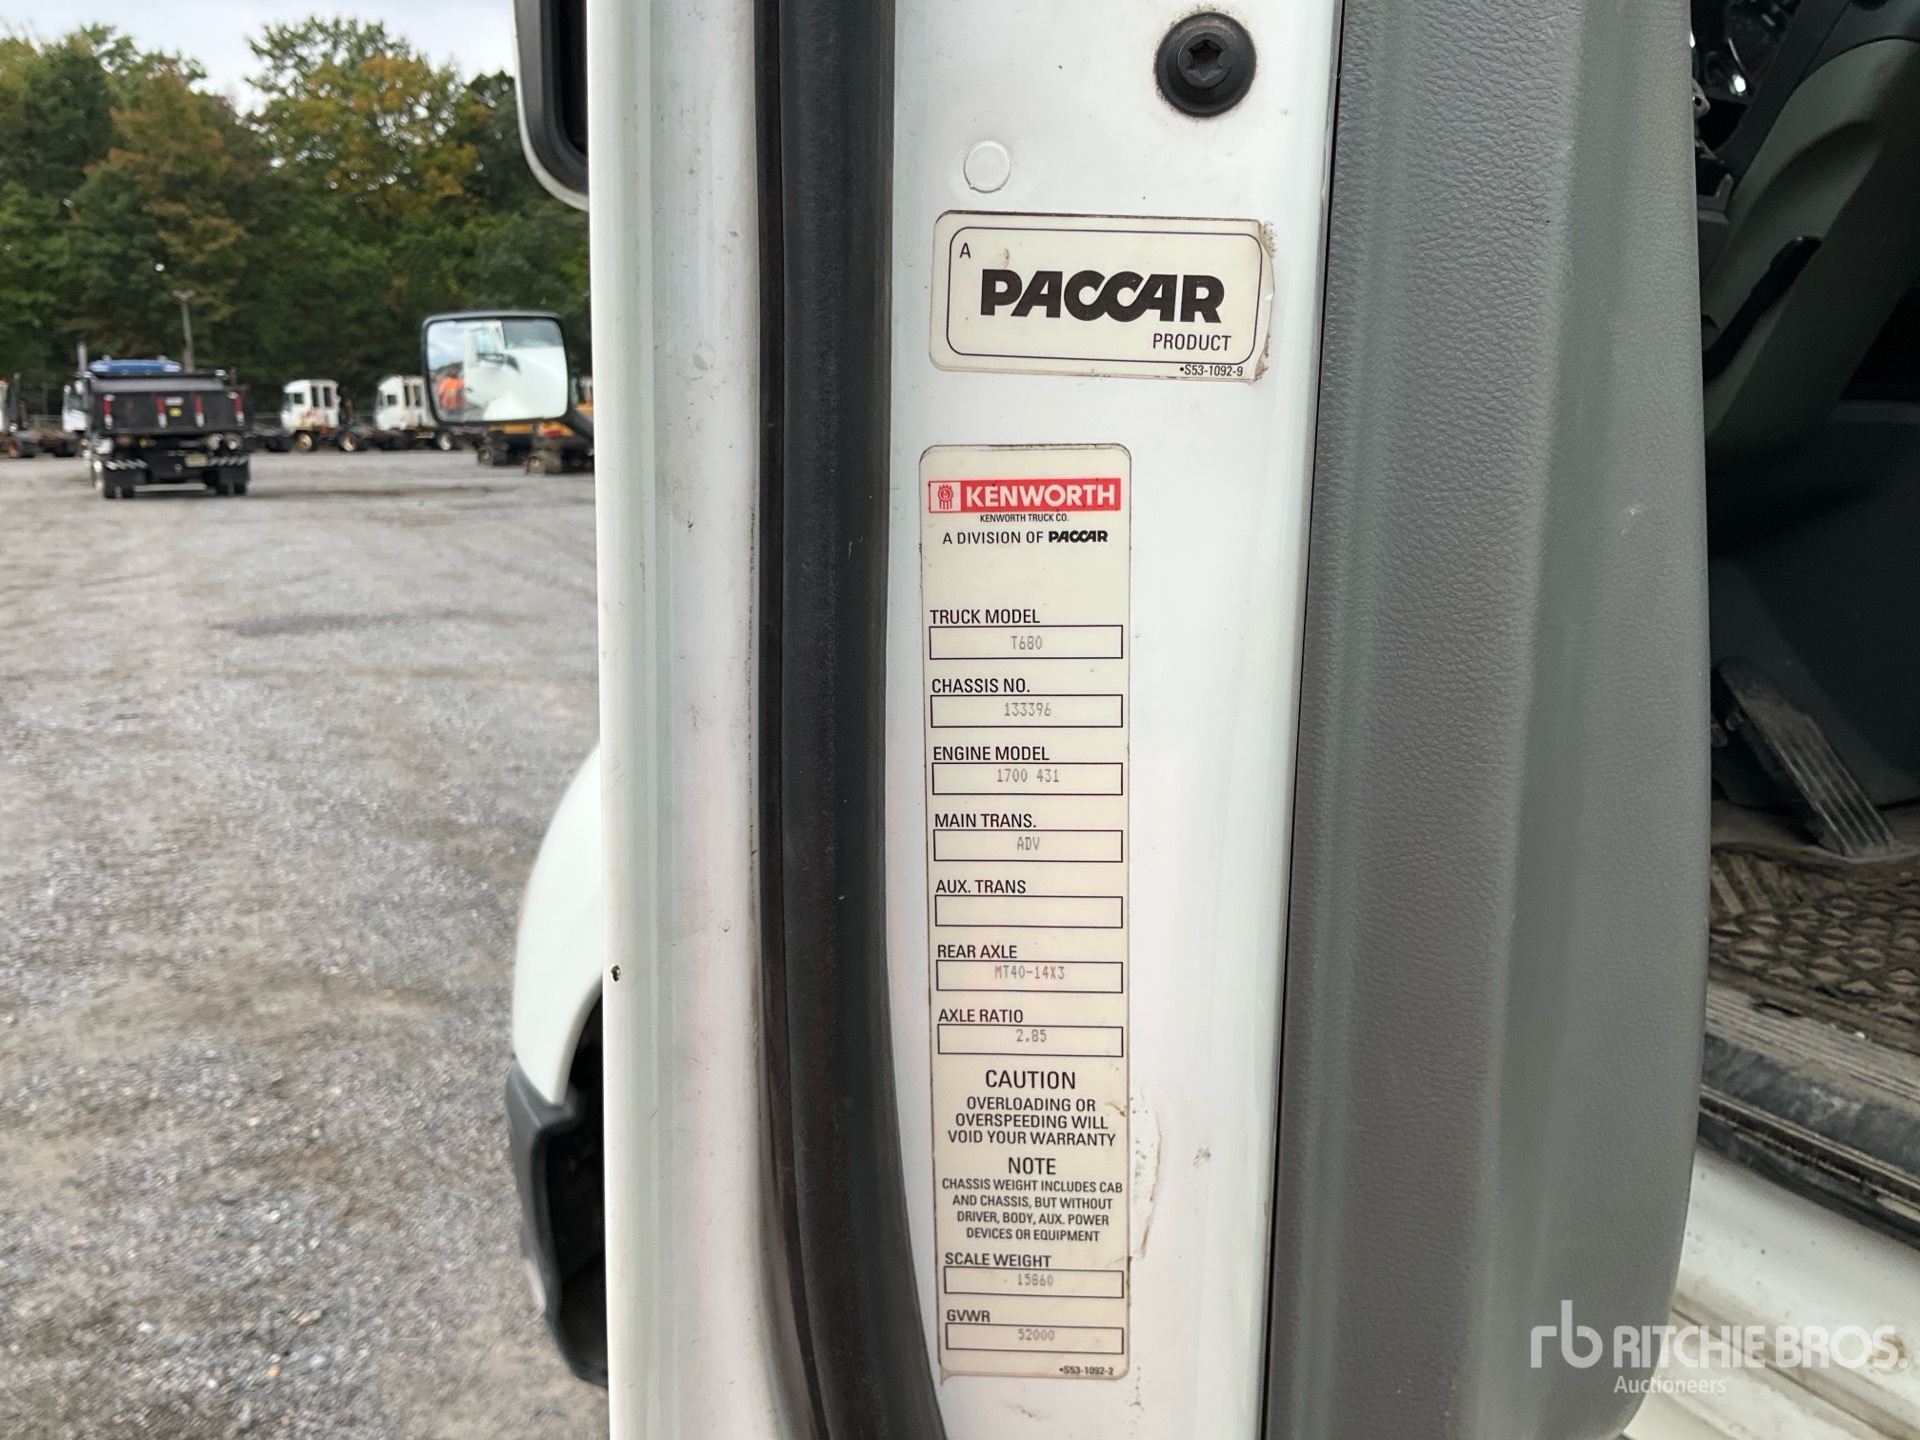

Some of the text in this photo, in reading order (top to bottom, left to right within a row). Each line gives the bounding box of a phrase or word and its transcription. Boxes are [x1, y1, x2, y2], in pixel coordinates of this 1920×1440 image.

[959, 242, 971, 258] A
[980, 269, 1225, 323] PACCAR
[1152, 333, 1232, 352] PRODUCT
[966, 484, 1115, 507] KENWORTH
[943, 530, 1108, 544] A DIVISION OF PACCAR
[930, 609, 1040, 624] TRUCK MODEL
[1011, 636, 1043, 650] T680
[932, 678, 1030, 692] CHASSIS NO.
[1004, 703, 1051, 717] 133396
[933, 746, 1049, 760] ENGINE MODEL
[997, 769, 1059, 782] 1700 431
[935, 814, 1036, 828] MAIN TRANS.
[1017, 837, 1040, 850] ADV
[936, 880, 1026, 893] AUX. TRANS
[938, 945, 1017, 958] REAR AXLE
[995, 965, 1065, 980] MT40-14X3
[938, 1009, 1023, 1023] AXLE RATIO
[1016, 1029, 1047, 1042] 2.85
[985, 1070, 1076, 1089] CAUTION
[967, 1097, 1096, 1111] OVERLOADING OR
[956, 1114, 1108, 1129] OVERSPEEDING WILL
[948, 1130, 1116, 1146] VOID YOUR WARRANTY
[1008, 1158, 1056, 1174] NOTE
[942, 1178, 1123, 1193] CHASSIS WEIGHT INCLUDES CAB
[952, 1195, 1113, 1209] AND CHASSIS, BUT WITHOUT
[957, 1211, 1109, 1226] DRIVER, BODY, AUX. POWER
[966, 1228, 1100, 1242] DEVICES OR EQUIPMENT
[945, 1253, 1051, 1267] SCALE WEIGHT
[947, 1310, 990, 1322] GVWR
[1019, 1329, 1055, 1341] 52000
